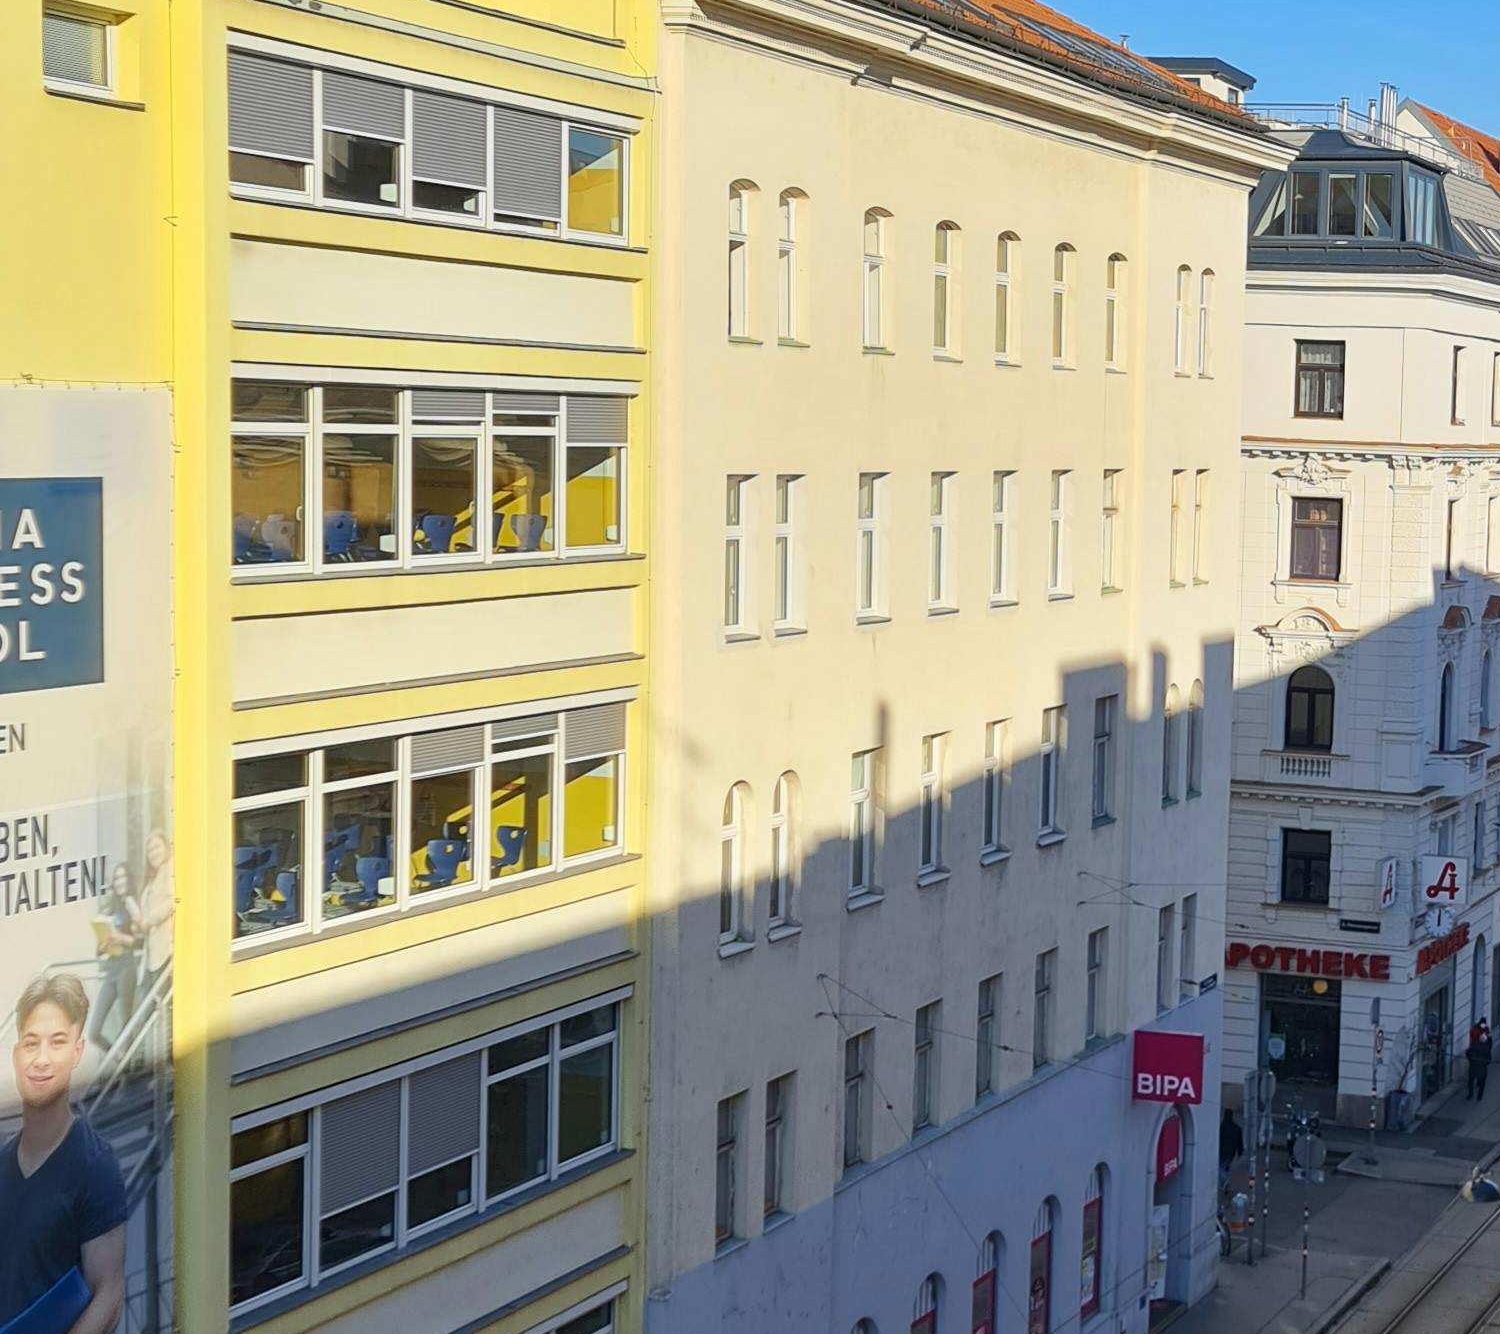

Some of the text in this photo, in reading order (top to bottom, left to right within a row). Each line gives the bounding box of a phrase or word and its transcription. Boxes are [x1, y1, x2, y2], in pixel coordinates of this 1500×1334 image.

[0, 508, 45, 550] A
[0, 855, 108, 917] TALTEN!
[1226, 942, 1391, 981] POTHEKE
[1136, 1072, 1196, 1099] BIPA
